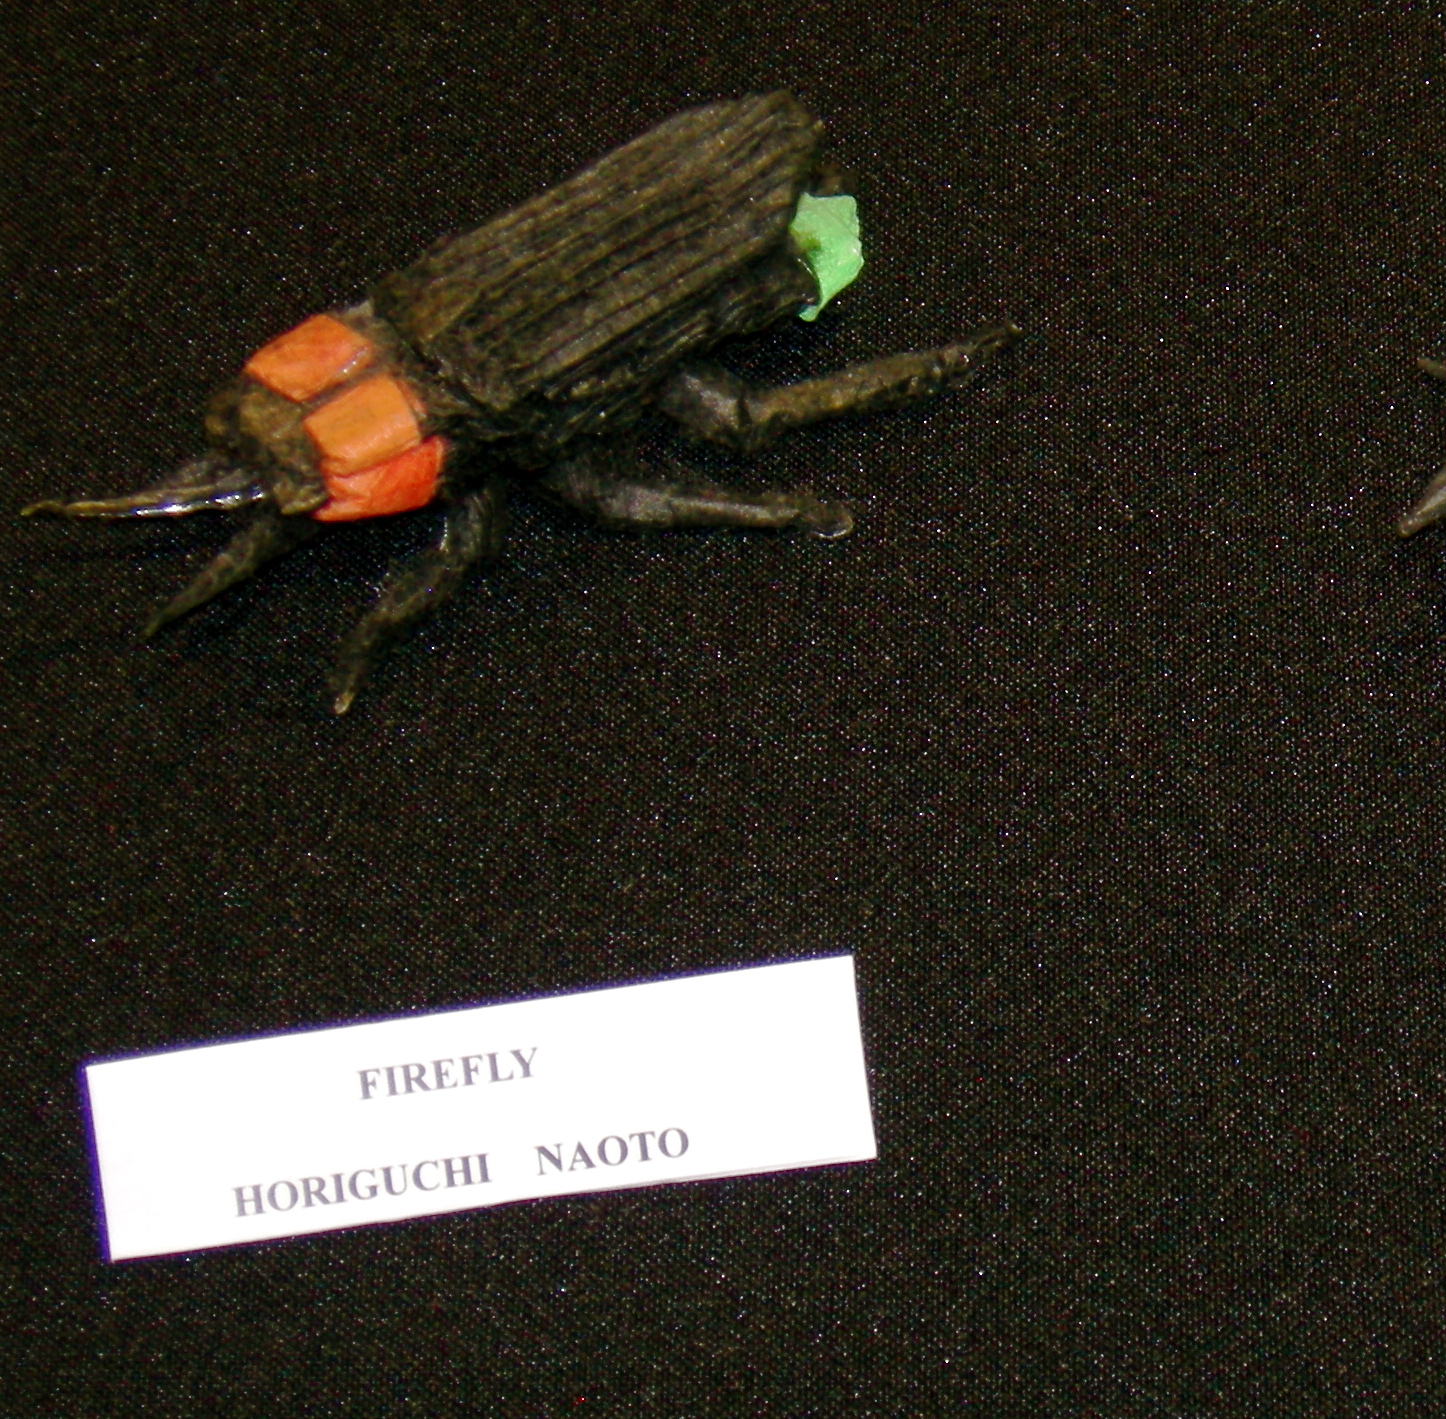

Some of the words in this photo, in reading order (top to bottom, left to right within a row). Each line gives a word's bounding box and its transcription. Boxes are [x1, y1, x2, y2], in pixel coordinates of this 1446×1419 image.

[358, 1047, 539, 1100] FIREFLY
[233, 1153, 492, 1217] HORIGUCHI
[535, 1127, 691, 1176] NAOTO
